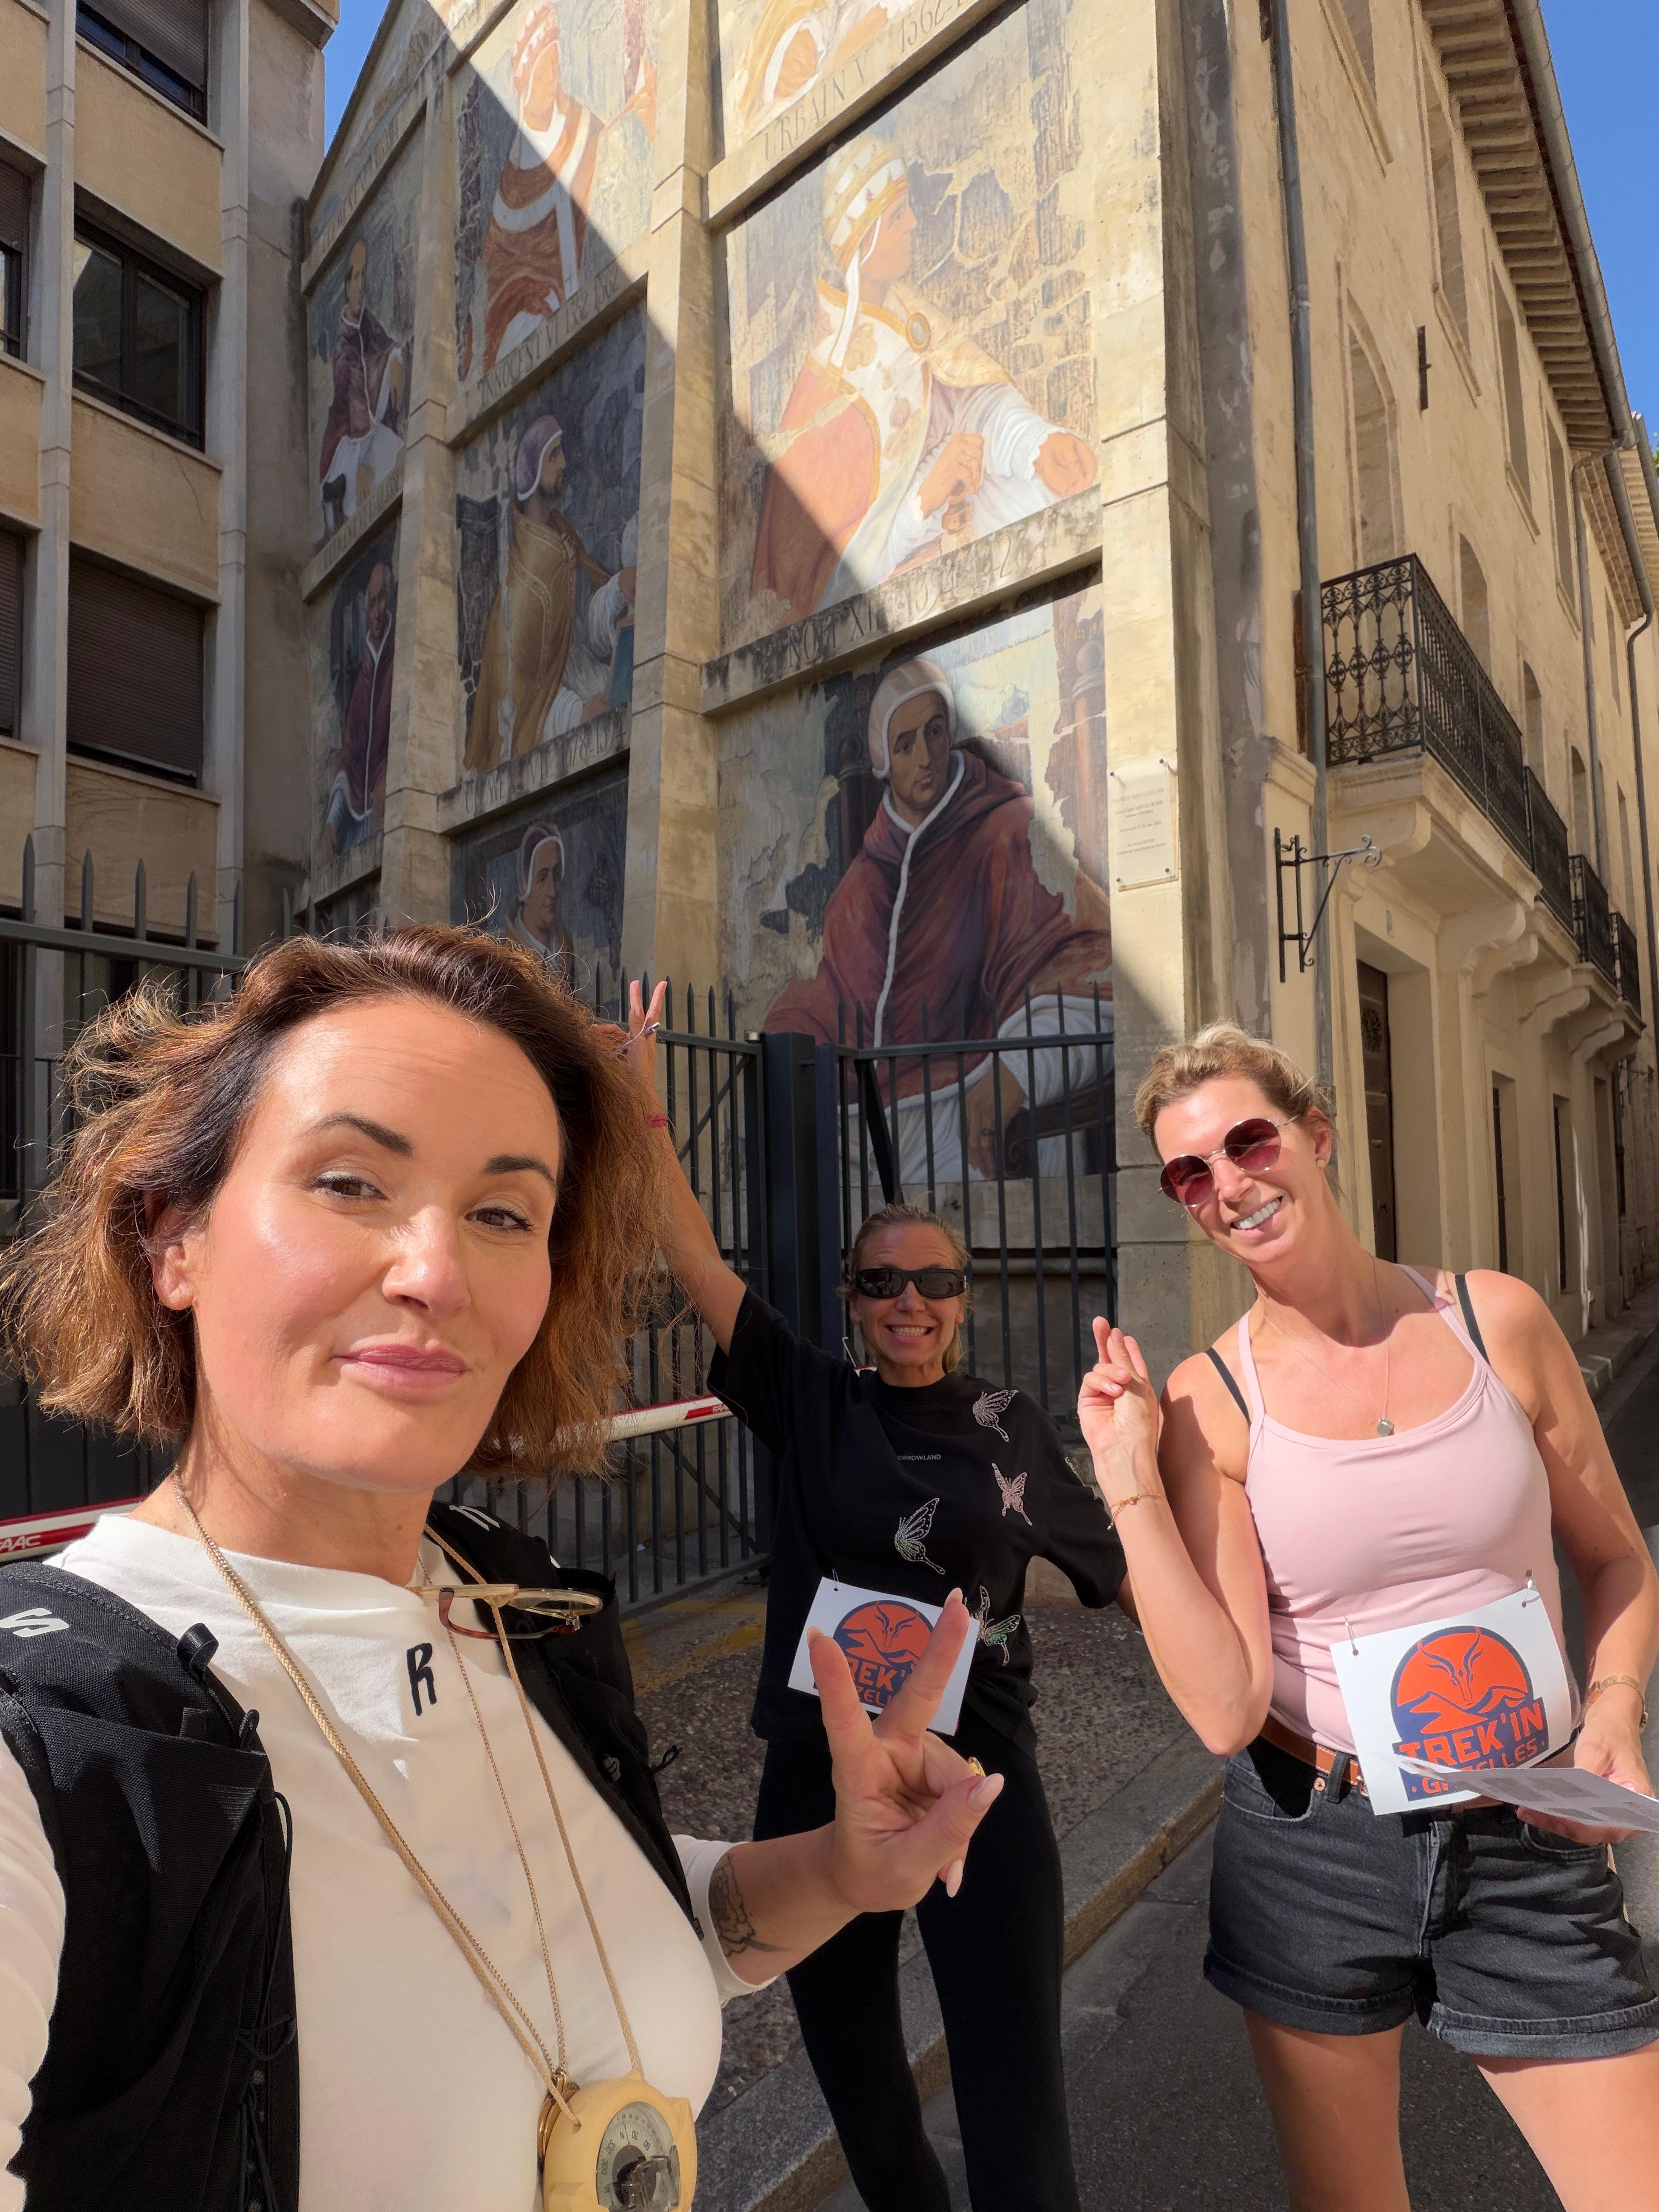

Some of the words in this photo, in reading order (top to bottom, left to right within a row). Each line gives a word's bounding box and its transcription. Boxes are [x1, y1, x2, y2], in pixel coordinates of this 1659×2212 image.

[764, 69, 846, 162] URBAIN
[899, 0, 963, 55] 1362-
[0, 1535, 42, 1551] AAC
[406, 1642, 437, 1716] R
